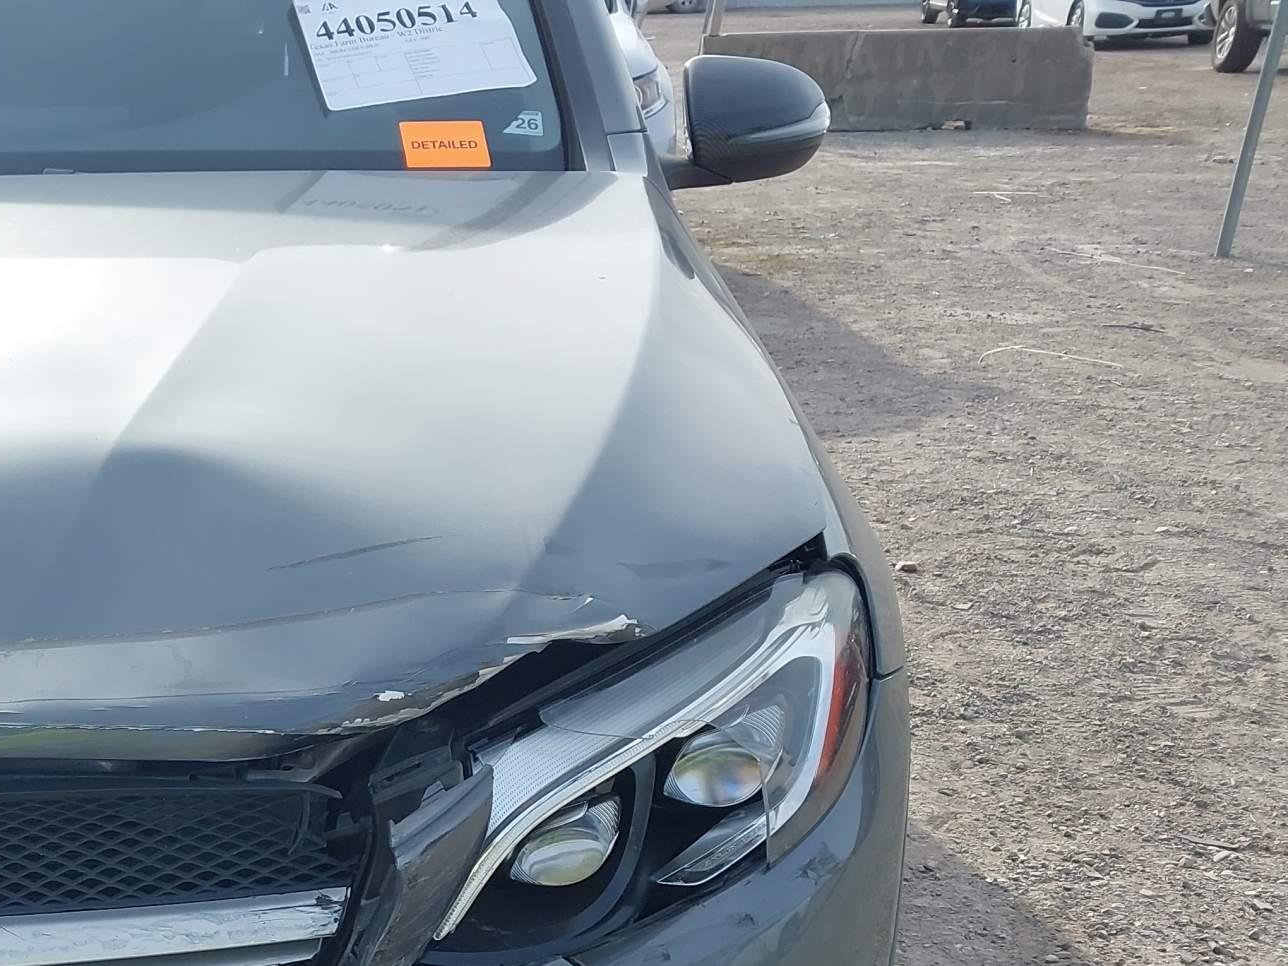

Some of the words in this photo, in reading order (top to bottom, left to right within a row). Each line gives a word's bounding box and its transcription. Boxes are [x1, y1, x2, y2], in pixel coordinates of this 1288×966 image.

[315, 1, 478, 41] 44050514
[515, 117, 539, 130] 26
[410, 139, 478, 151] DETAILED
